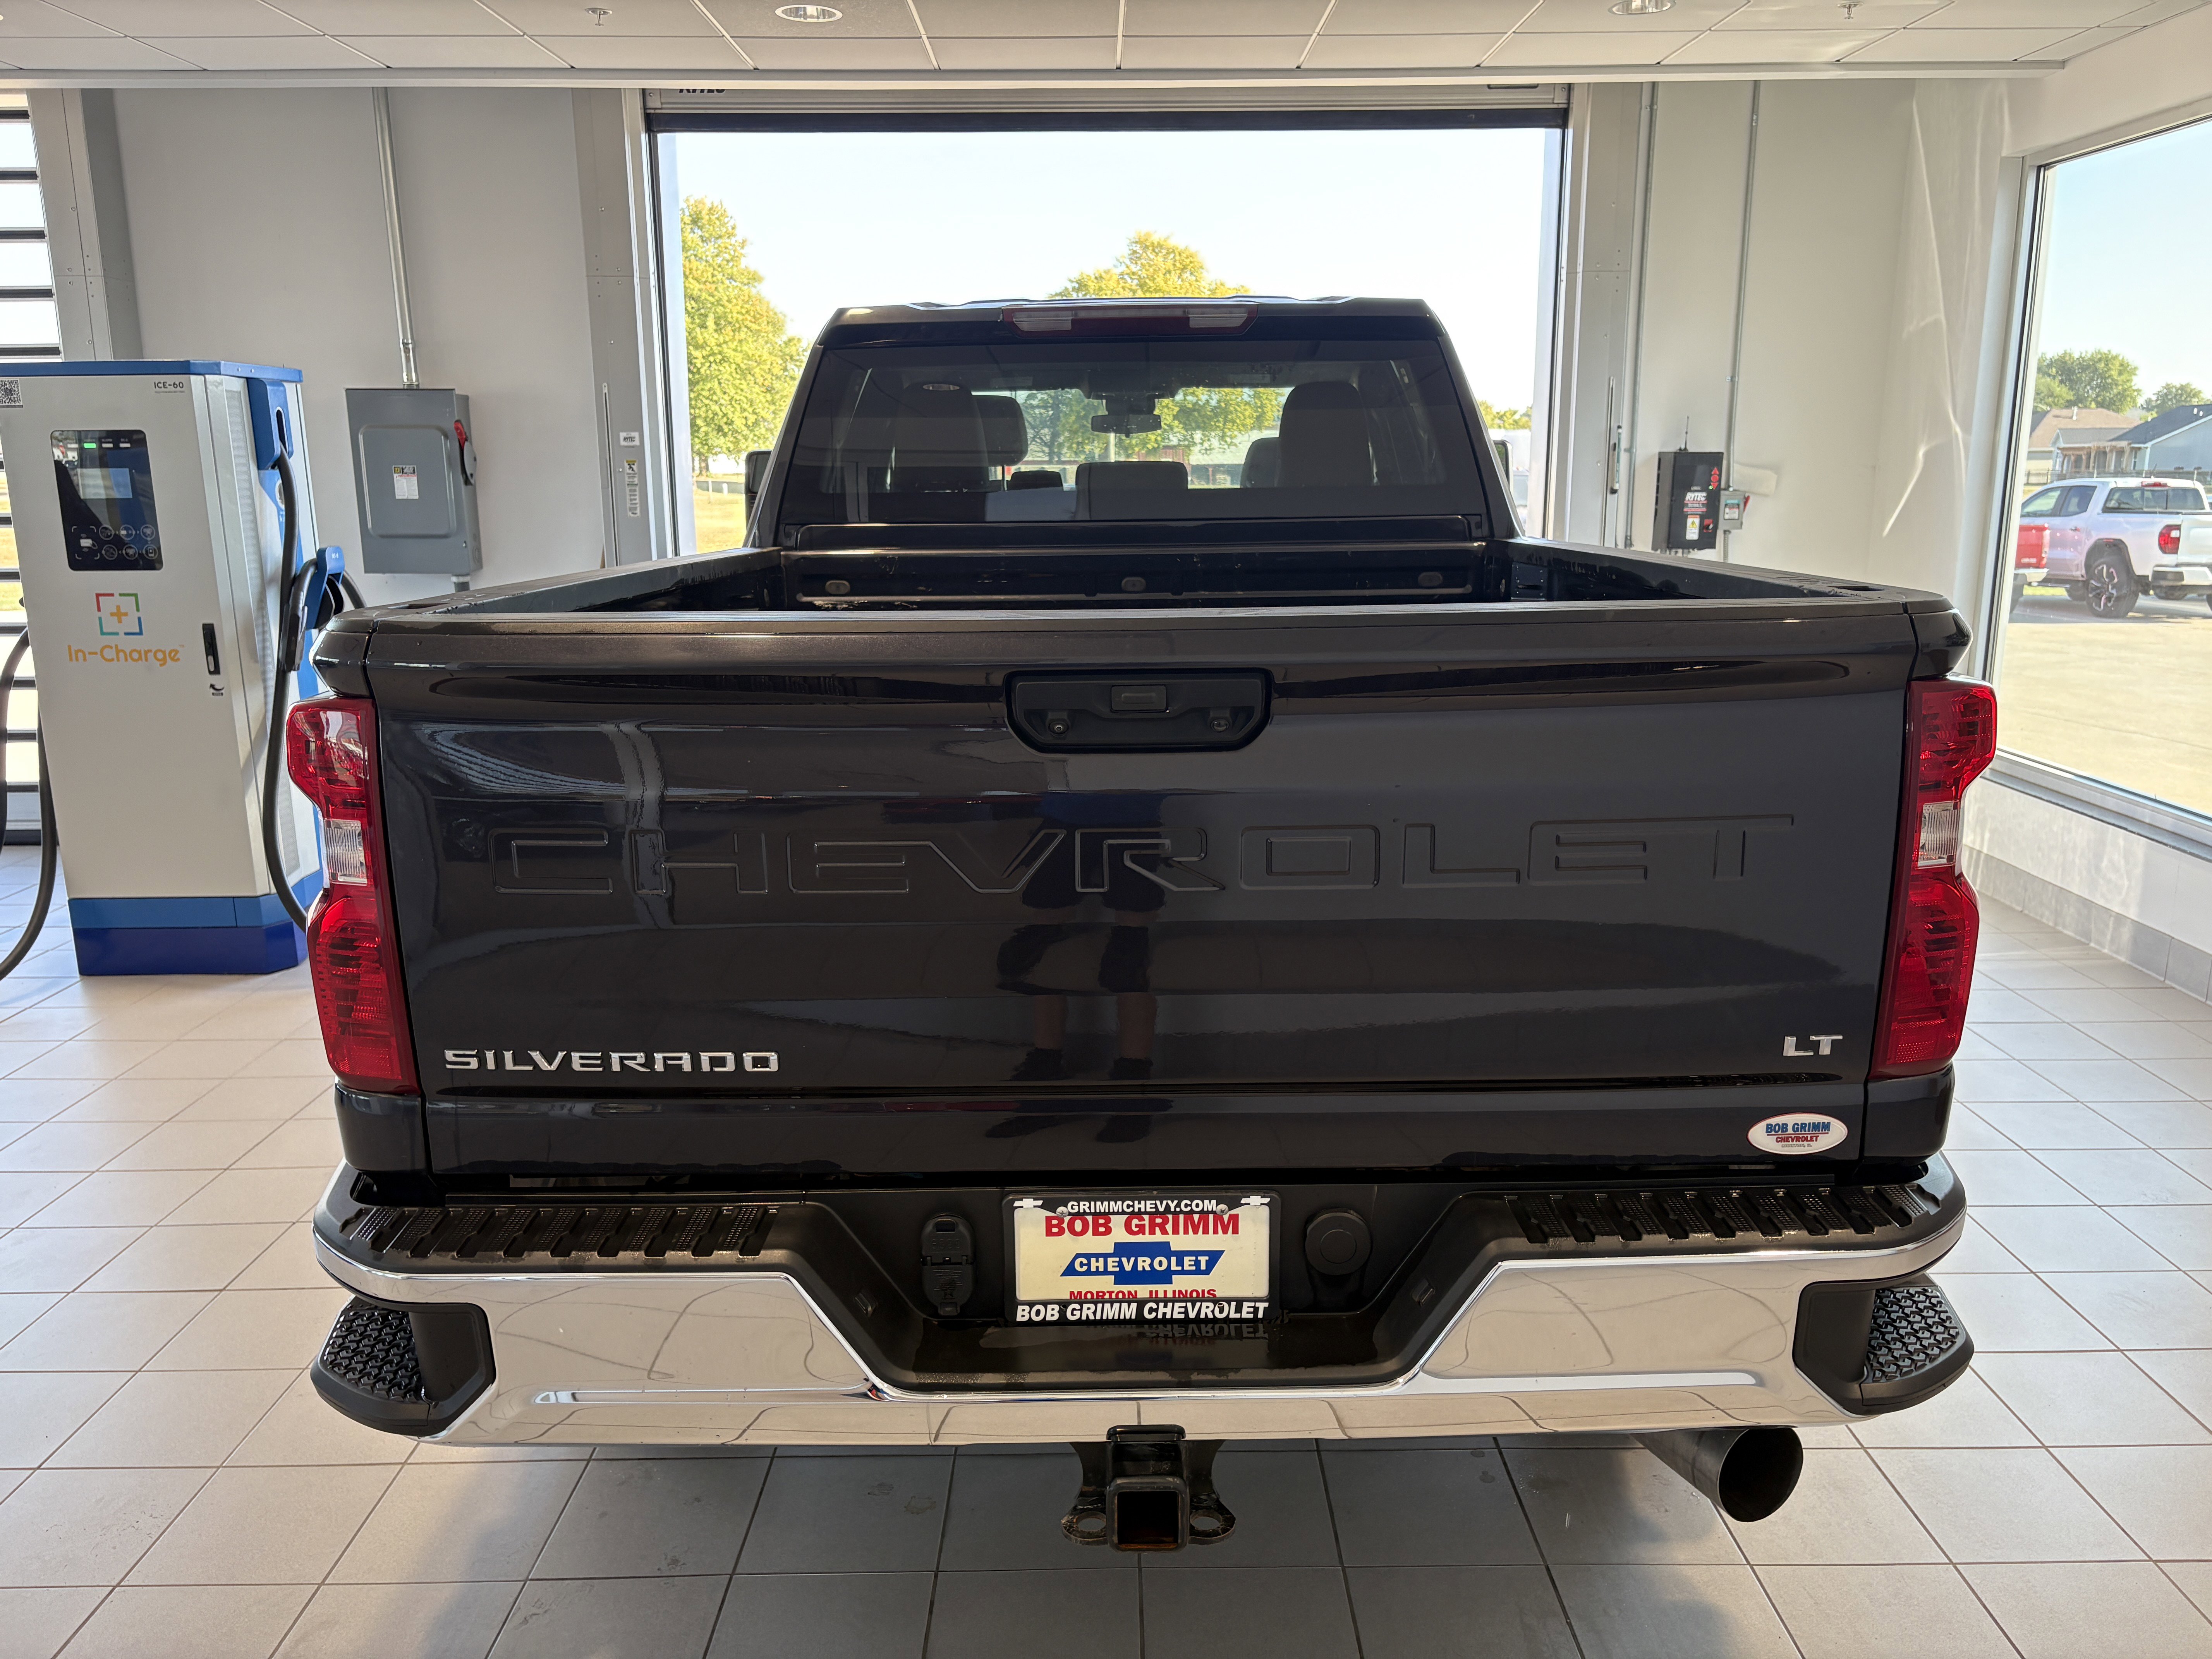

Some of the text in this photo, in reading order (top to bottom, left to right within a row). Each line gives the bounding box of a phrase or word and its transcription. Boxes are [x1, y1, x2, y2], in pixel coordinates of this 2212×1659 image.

[67, 644, 180, 667] In-Charge
[488, 814, 1795, 893] CHEVROLET
[1783, 1034, 1843, 1056] LT
[444, 1049, 780, 1072] SILVERADO
[1765, 1122, 1831, 1133] BOB GRIMM
[1776, 1135, 1819, 1143] CHEVROLET
[1067, 1200, 1216, 1213] GRIMMCHEVY.COM
[1045, 1214, 1239, 1237] BOB GRIMM
[1074, 1256, 1209, 1272] CHEVROLET
[1069, 1290, 1138, 1300] MORTON
[1016, 1302, 1269, 1321] BOB GRIMM CHEVROLET
